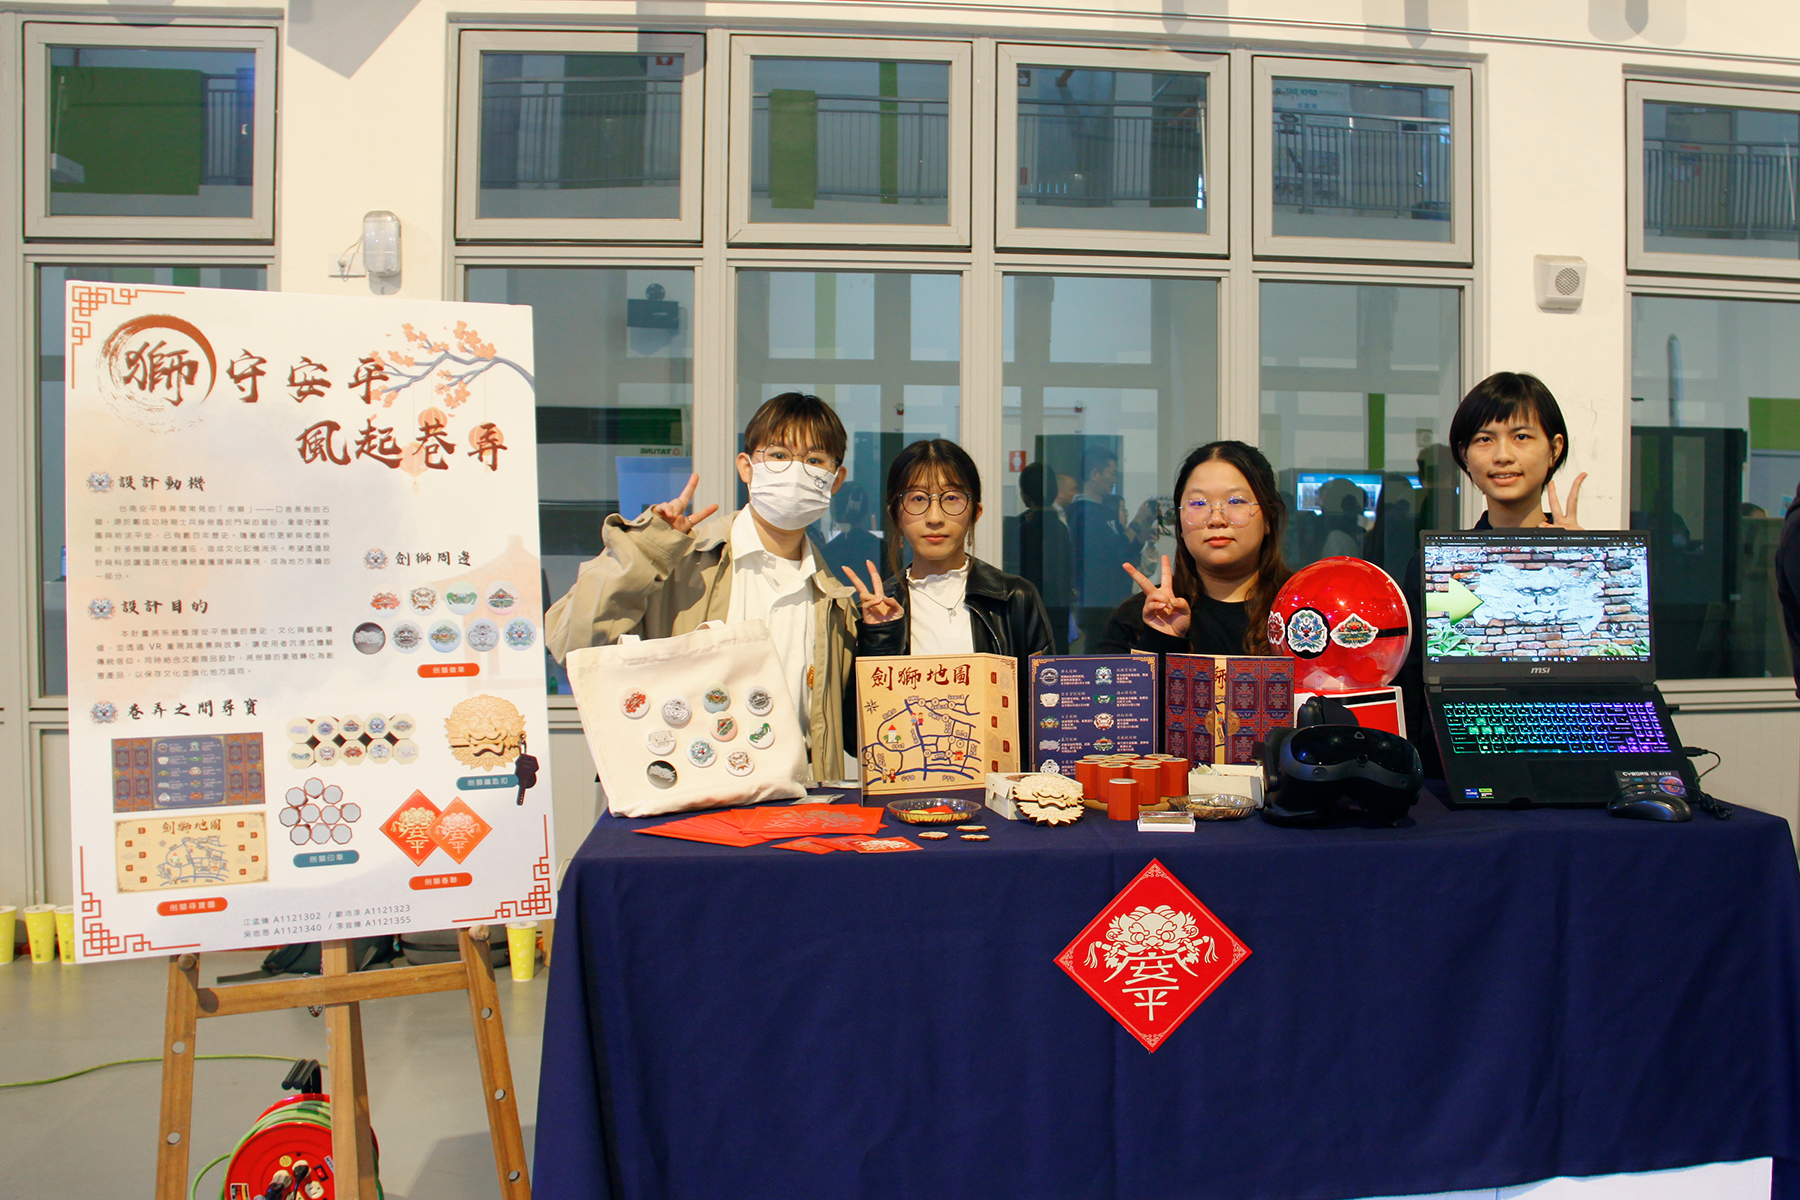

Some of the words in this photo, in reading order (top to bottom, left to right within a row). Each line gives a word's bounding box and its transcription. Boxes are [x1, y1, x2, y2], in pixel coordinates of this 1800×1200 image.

[123, 340, 389, 406] 獅守安平
[295, 417, 508, 471] 風起巷弄
[118, 475, 205, 491] 設計動機
[395, 550, 471, 566] 劍獅周邊
[121, 599, 208, 615] 設計目的
[870, 664, 971, 691] 劍獅地圖
[127, 697, 258, 720] 巷弄之間尋寶
[162, 818, 222, 835] 劍獅地圖
[273, 912, 321, 924] A1121302
[364, 904, 411, 915] A1121323
[273, 923, 322, 935] A1121340
[365, 915, 411, 927] A1121355
